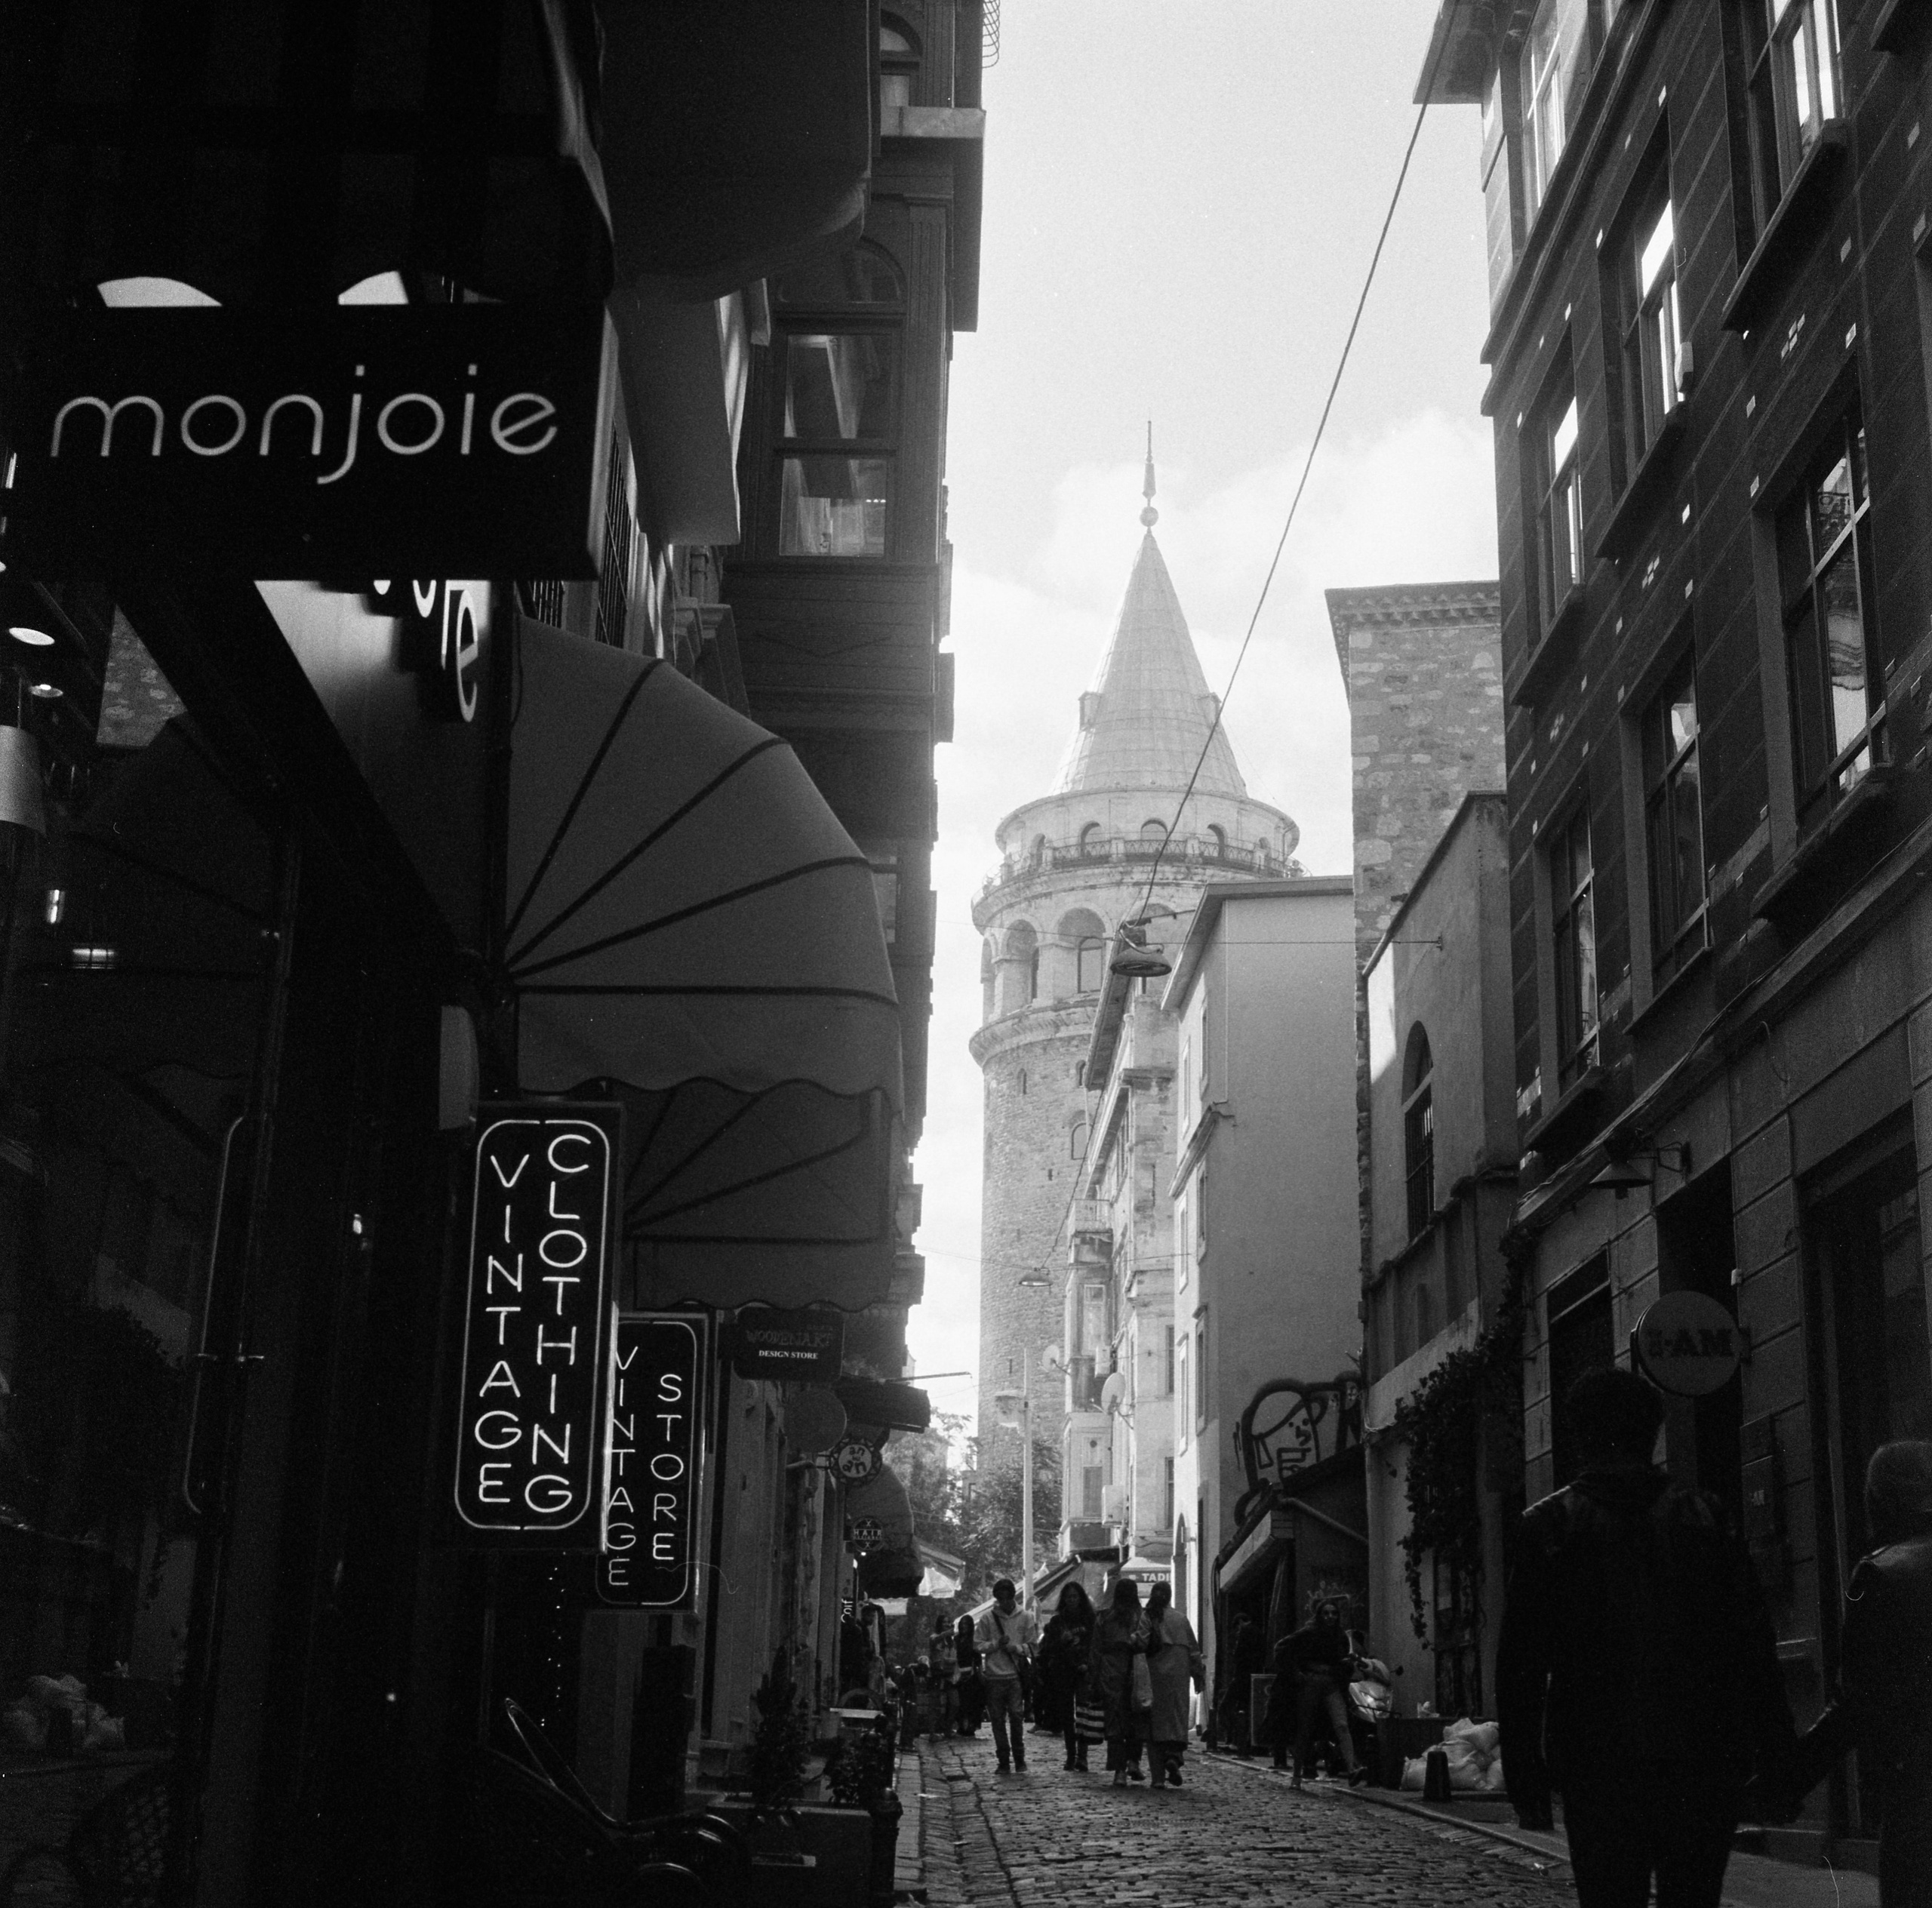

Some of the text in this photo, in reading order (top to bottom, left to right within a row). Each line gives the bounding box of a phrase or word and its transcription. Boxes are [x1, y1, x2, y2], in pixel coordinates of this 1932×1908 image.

[51, 363, 558, 485] monjoie
[474, 1153, 530, 1503] VINTAGE
[524, 1134, 592, 1514] CLOTHING
[758, 1349, 819, 1360] DESIGN STORE
[605, 1346, 638, 1586] VINTAGE
[650, 1374, 685, 1561] STORE
